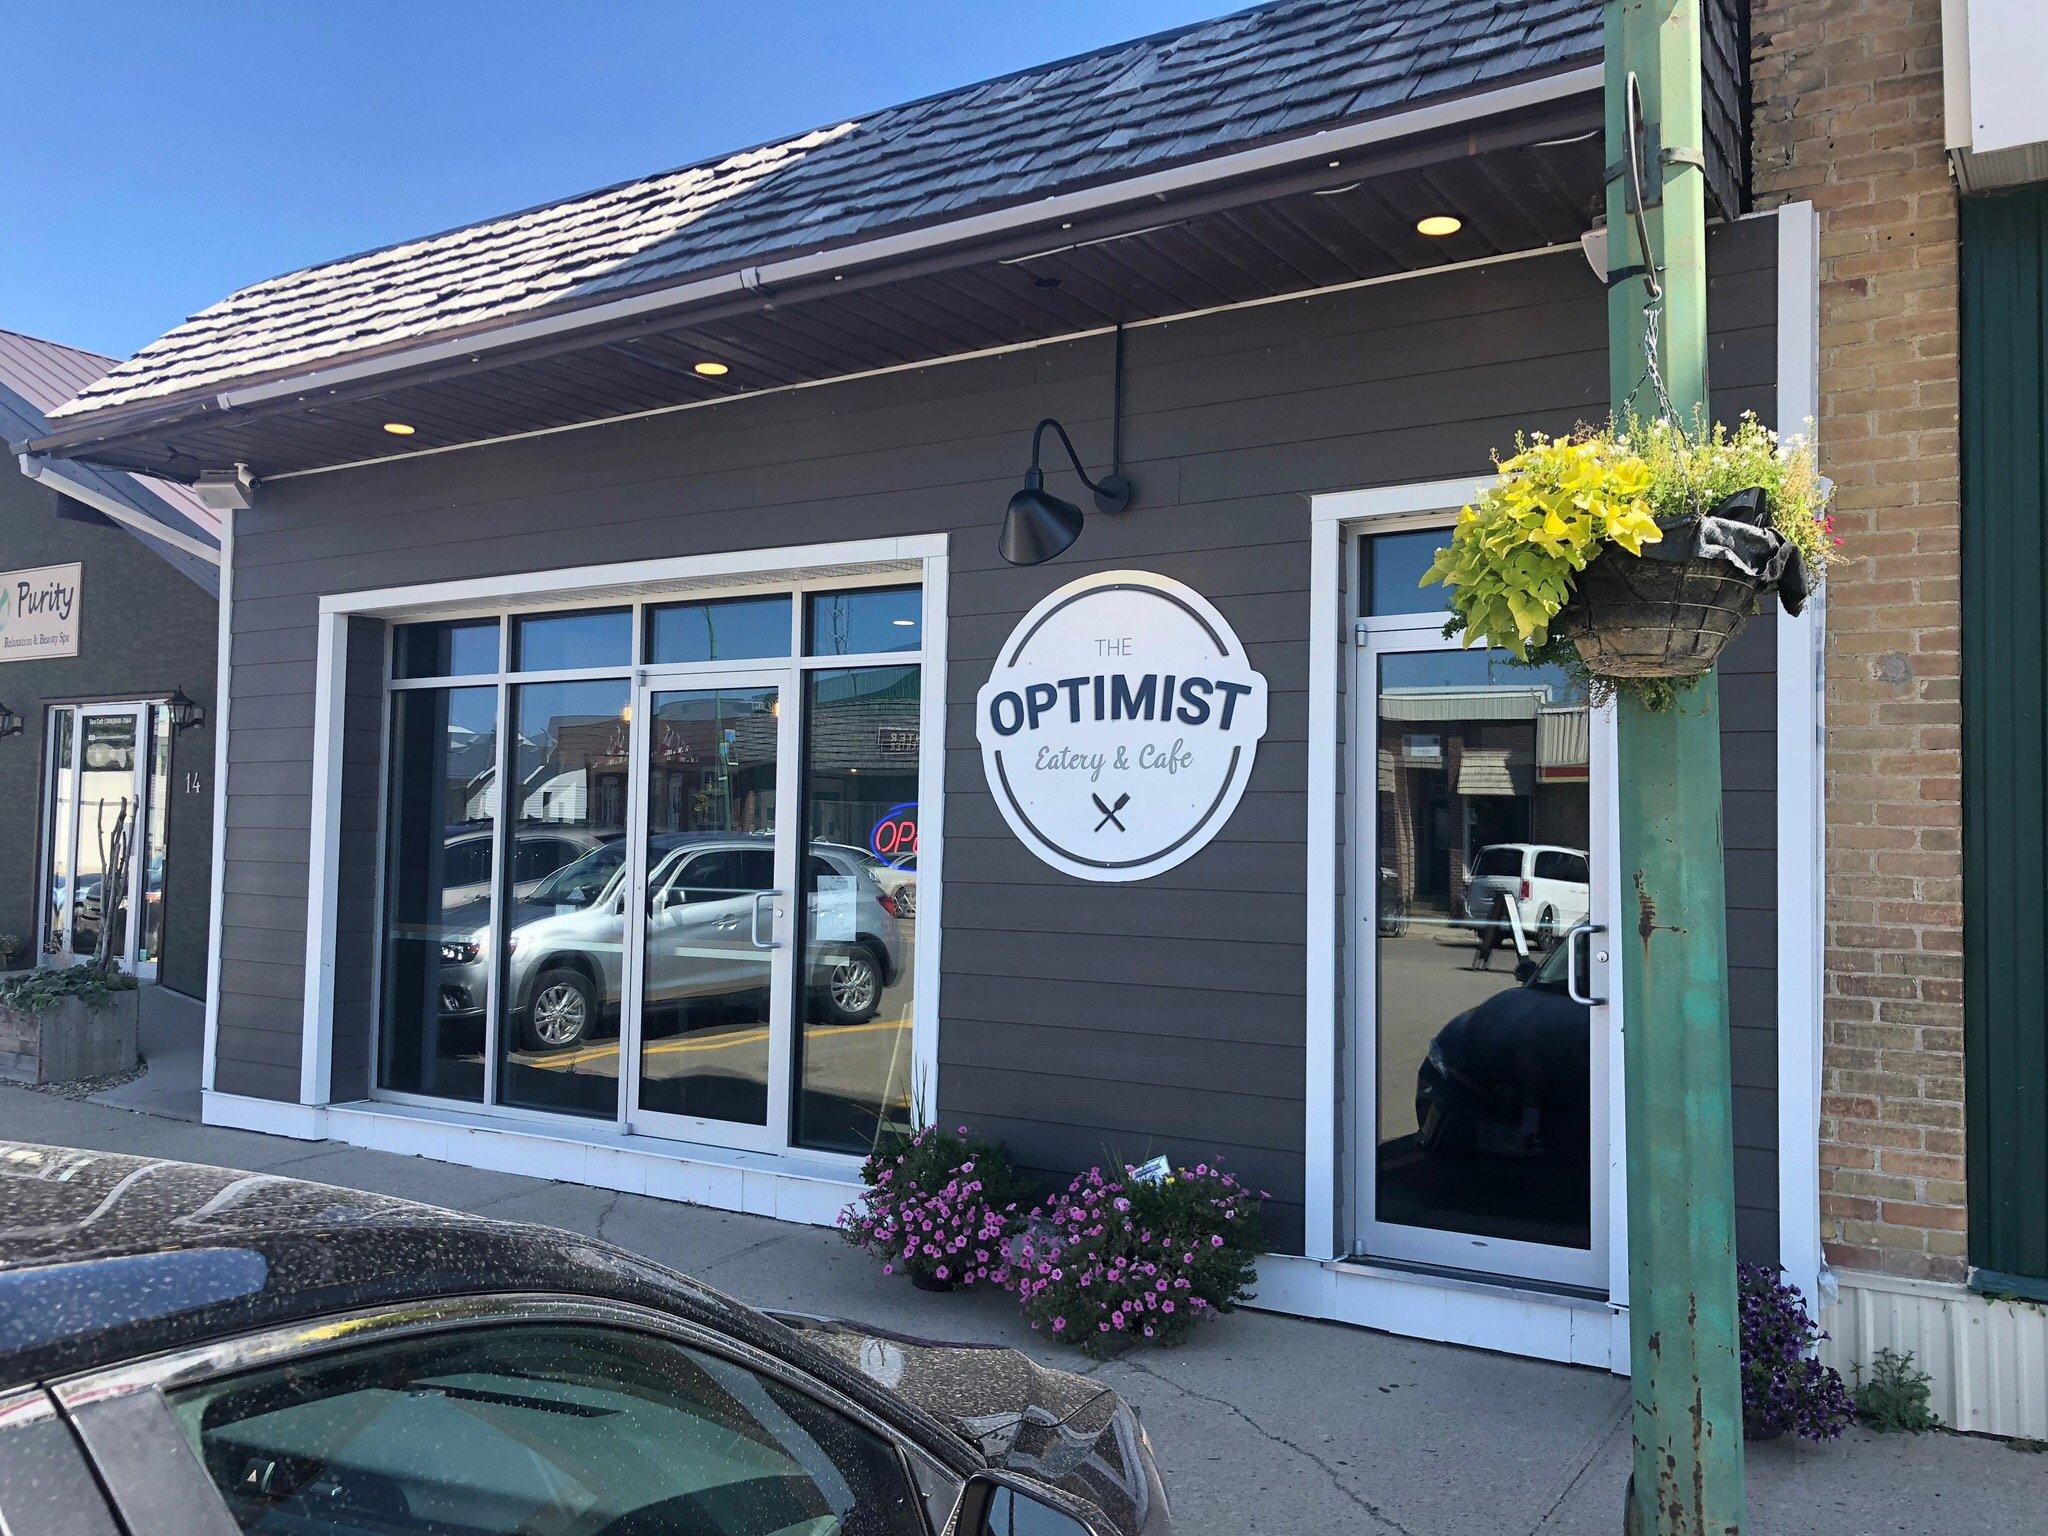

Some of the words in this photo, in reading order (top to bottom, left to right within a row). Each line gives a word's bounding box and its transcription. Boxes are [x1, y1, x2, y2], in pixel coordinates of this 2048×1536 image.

[17, 582, 74, 621] Purity
[4, 636, 32, 648] Relaxation
[33, 634, 39, 645] &
[40, 633, 59, 646] Beauty
[60, 632, 70, 645] Spa
[1095, 637, 1133, 657] THE
[990, 674, 1252, 736] OPTIMIST
[1035, 745, 1107, 783] Eatery
[1112, 745, 1130, 770] &
[1138, 737, 1195, 775] Cafe
[185, 772, 201, 795] 14
